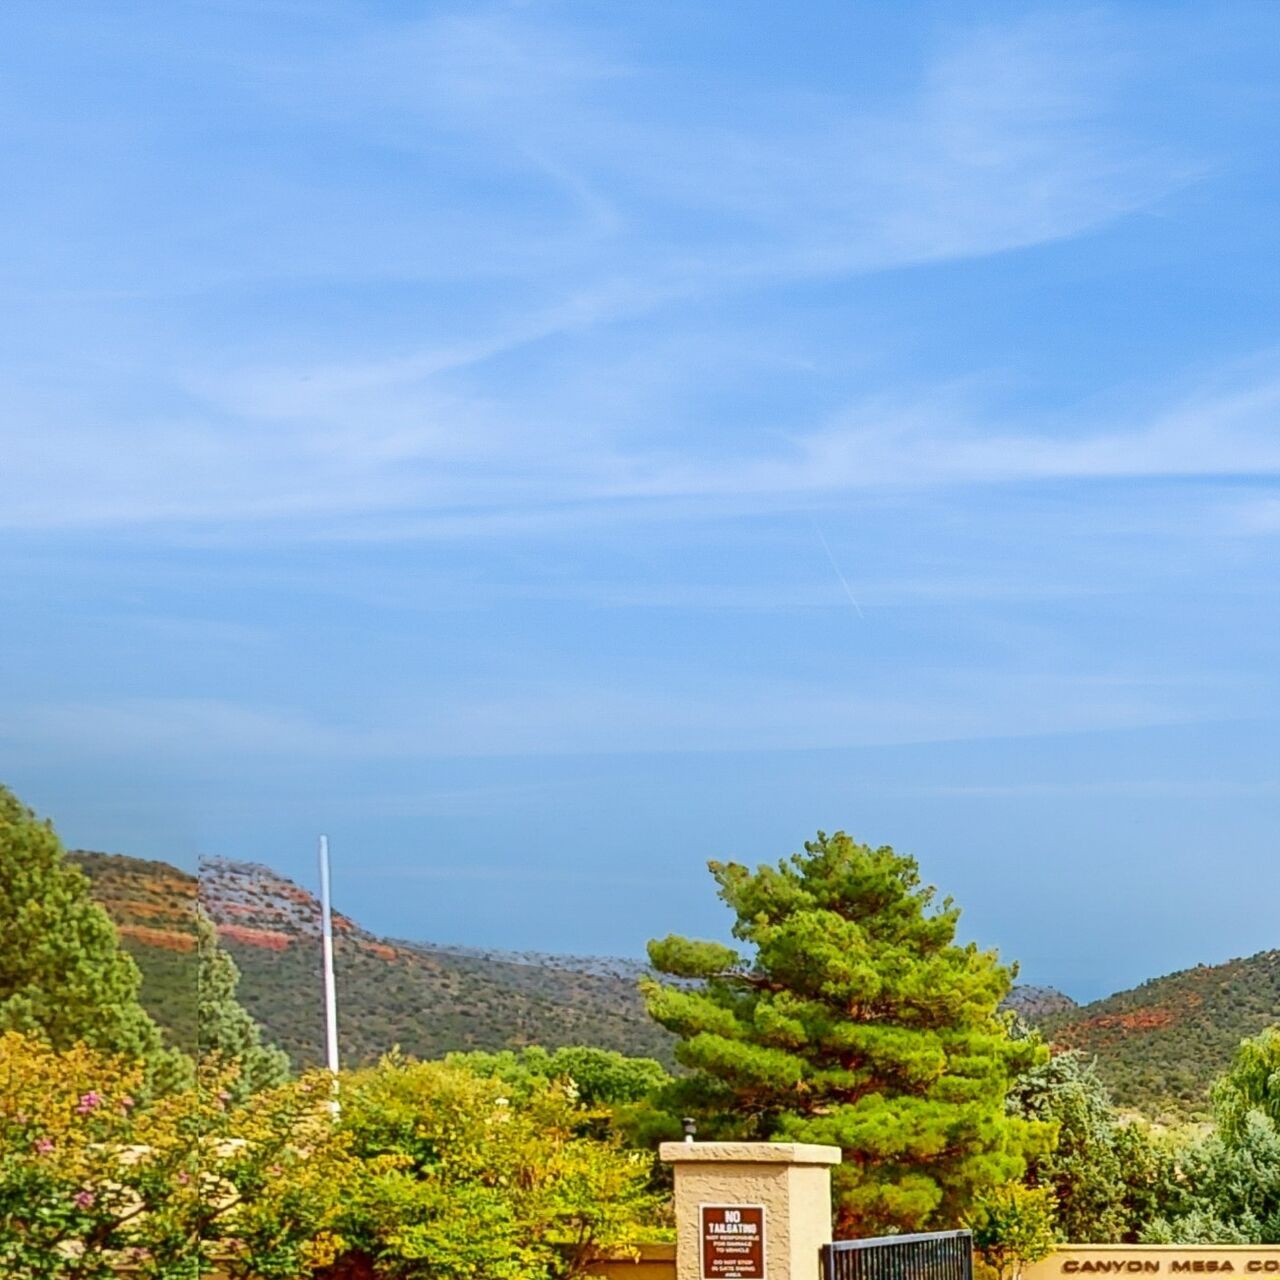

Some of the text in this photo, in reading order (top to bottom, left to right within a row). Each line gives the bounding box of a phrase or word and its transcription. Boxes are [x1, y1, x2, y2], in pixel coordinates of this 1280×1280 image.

[724, 1210, 741, 1223] NO
[708, 1223, 757, 1234] TAILGATING
[1063, 1260, 1160, 1273] CANYON
[1171, 1260, 1234, 1273] MESA
